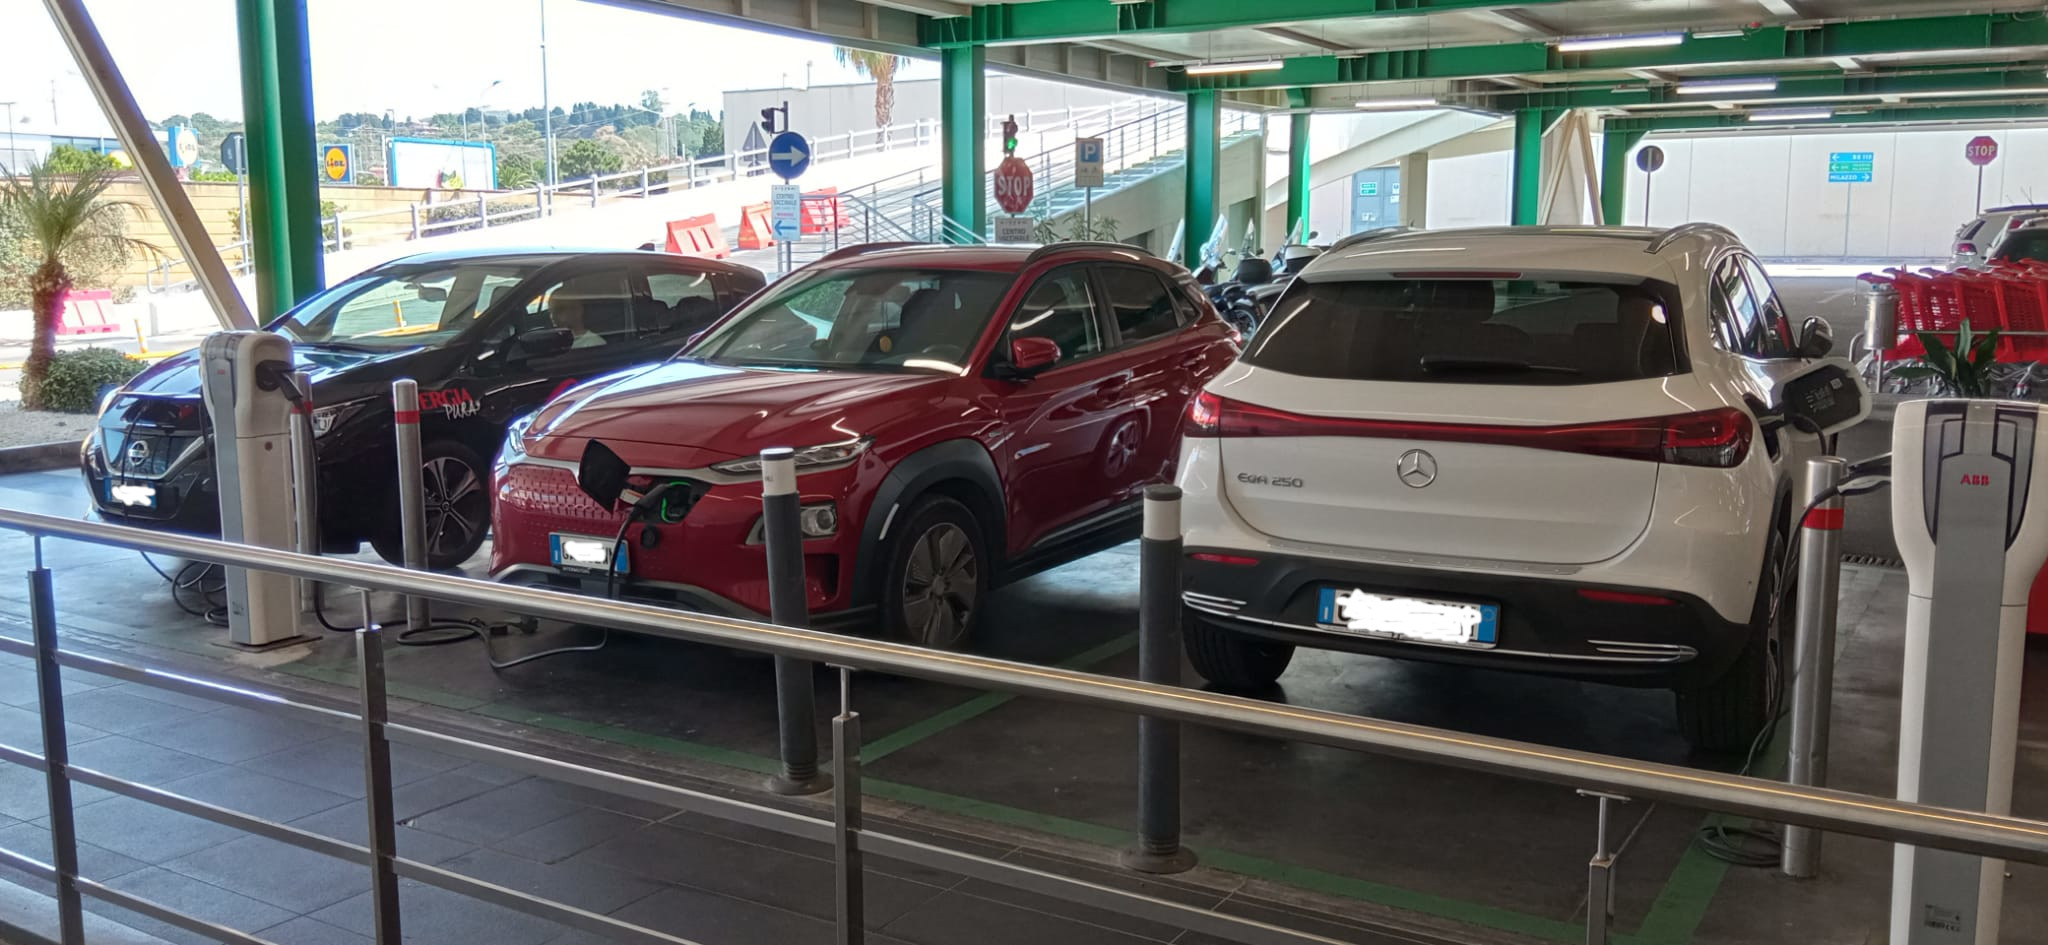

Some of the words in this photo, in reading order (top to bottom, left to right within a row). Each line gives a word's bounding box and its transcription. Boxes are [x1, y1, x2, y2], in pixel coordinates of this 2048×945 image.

[1085, 144, 1096, 160] P
[1968, 145, 1995, 157] STOP
[998, 175, 1030, 196] STOP
[1237, 472, 1268, 485] EQA
[1271, 476, 1304, 488] 250
[1960, 472, 1990, 486] ABB
